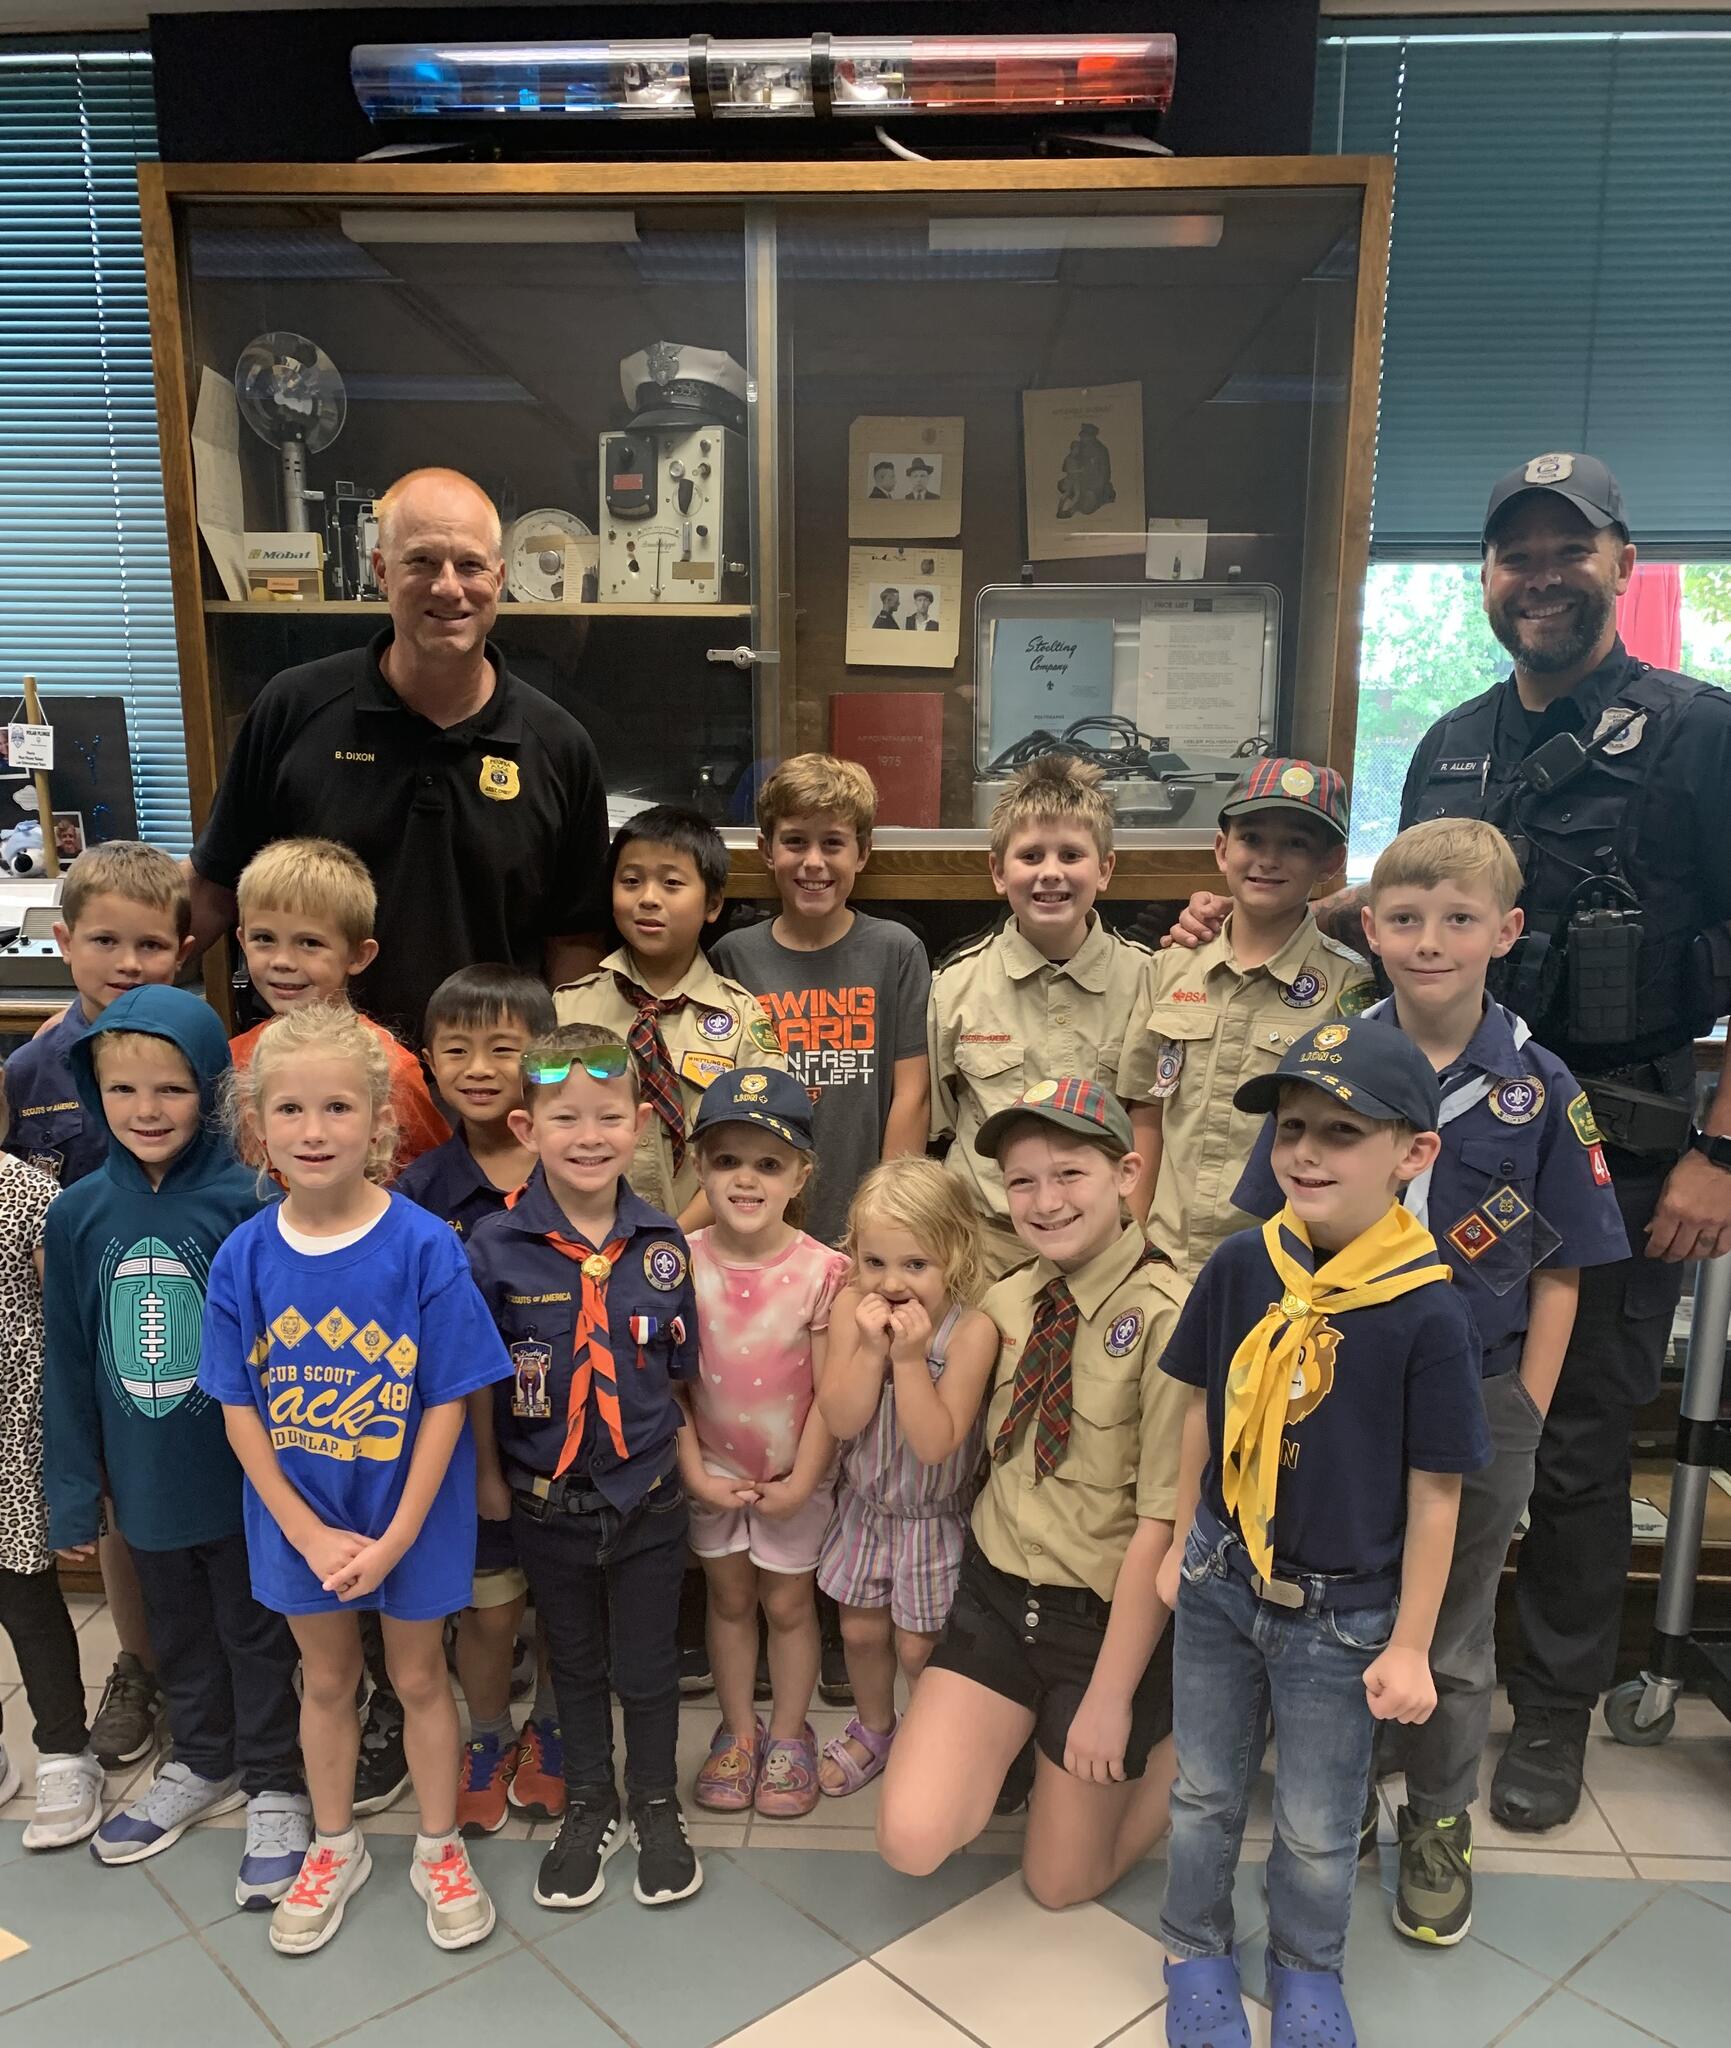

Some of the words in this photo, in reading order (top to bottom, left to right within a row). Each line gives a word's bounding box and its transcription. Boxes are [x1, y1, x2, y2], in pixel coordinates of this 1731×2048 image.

[1029, 655, 1069, 675] Company
[335, 750, 344, 760] B.
[346, 751, 375, 762] DIXON
[1450, 761, 1477, 771] ALLEN
[1185, 991, 1207, 1003] BSA
[774, 1016, 875, 1054] ARD
[805, 1050, 875, 1069] FAST
[1299, 1051, 1330, 1063] LION
[815, 1068, 875, 1085] LEFT
[733, 1093, 758, 1103] LION
[22, 1106, 46, 1117] SCOUTS
[53, 1101, 79, 1112] AMERICA
[541, 1291, 572, 1304] AMERICA
[269, 1365, 298, 1383] CUB
[304, 1365, 356, 1386] SCOUT
[268, 1374, 382, 1437] ack
[274, 1429, 343, 1459] DUNLAP,
